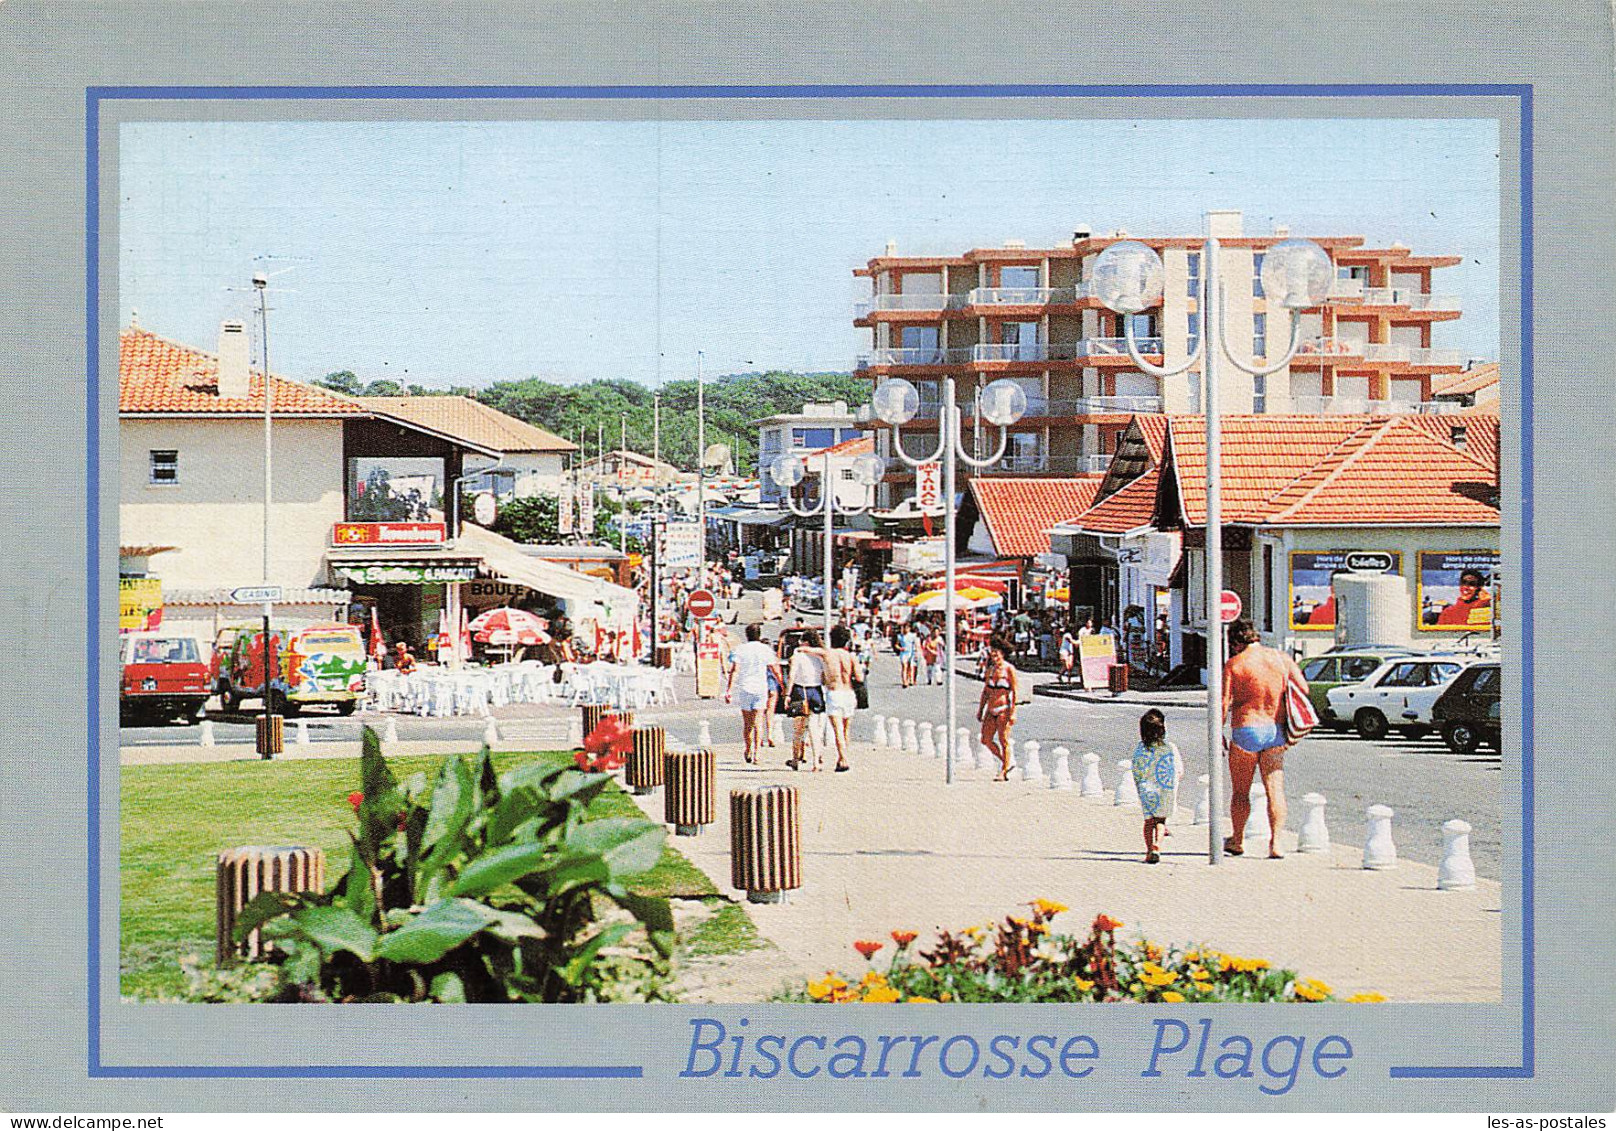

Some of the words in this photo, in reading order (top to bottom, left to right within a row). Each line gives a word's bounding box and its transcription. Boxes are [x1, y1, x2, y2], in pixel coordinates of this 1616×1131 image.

[918, 462, 938, 471] BAR
[921, 470, 935, 505] TABAC
[242, 589, 277, 599] CASINO
